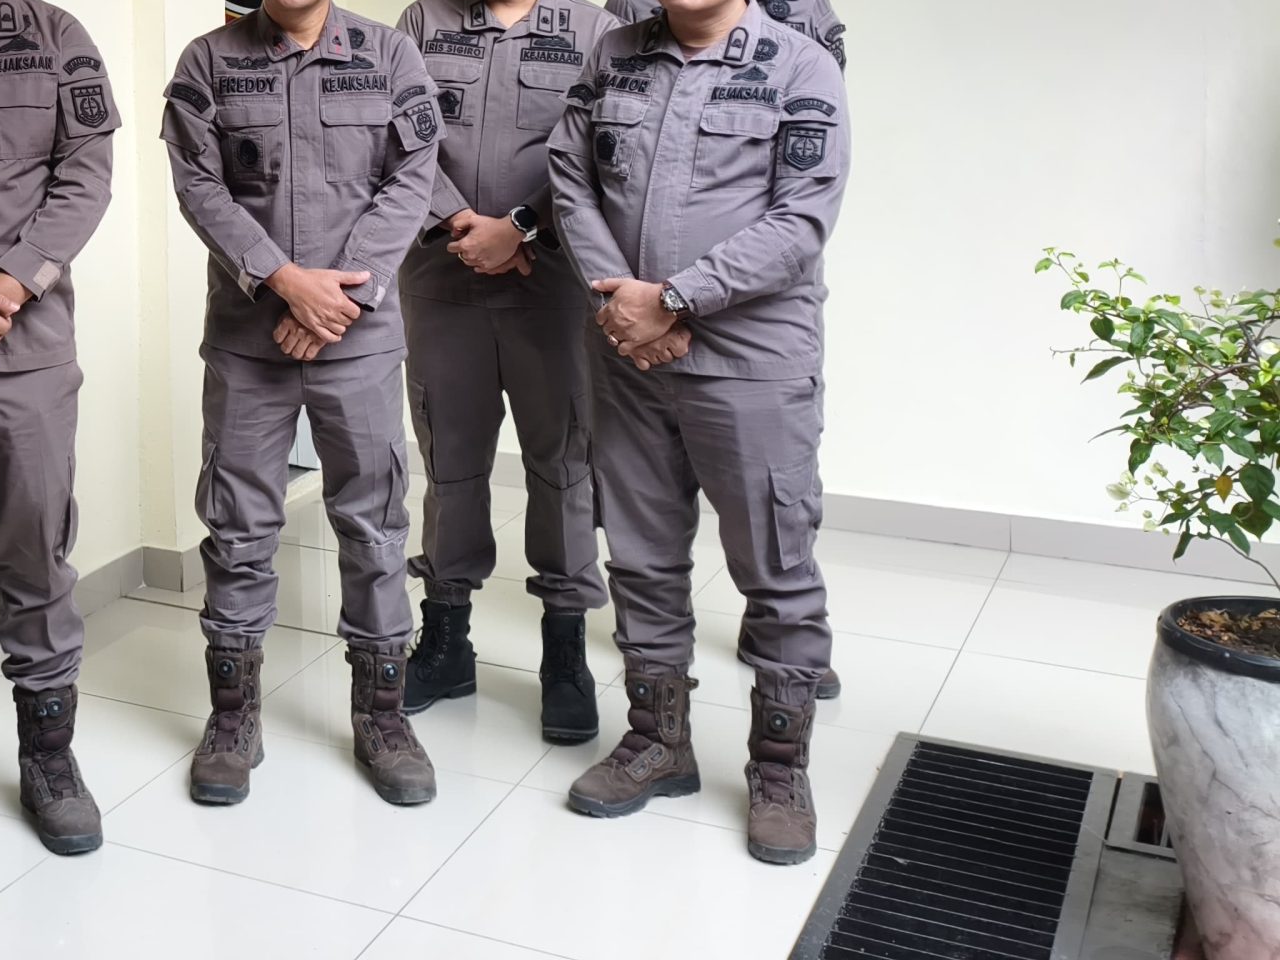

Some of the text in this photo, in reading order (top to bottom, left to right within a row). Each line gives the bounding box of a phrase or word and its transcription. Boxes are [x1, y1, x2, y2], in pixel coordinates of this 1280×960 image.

[523, 50, 580, 64] KEJAKSAAN
[220, 75, 277, 93] FREDDY
[321, 74, 388, 93] KEJAKSAAN
[710, 85, 778, 104] KEJAKSAAN
